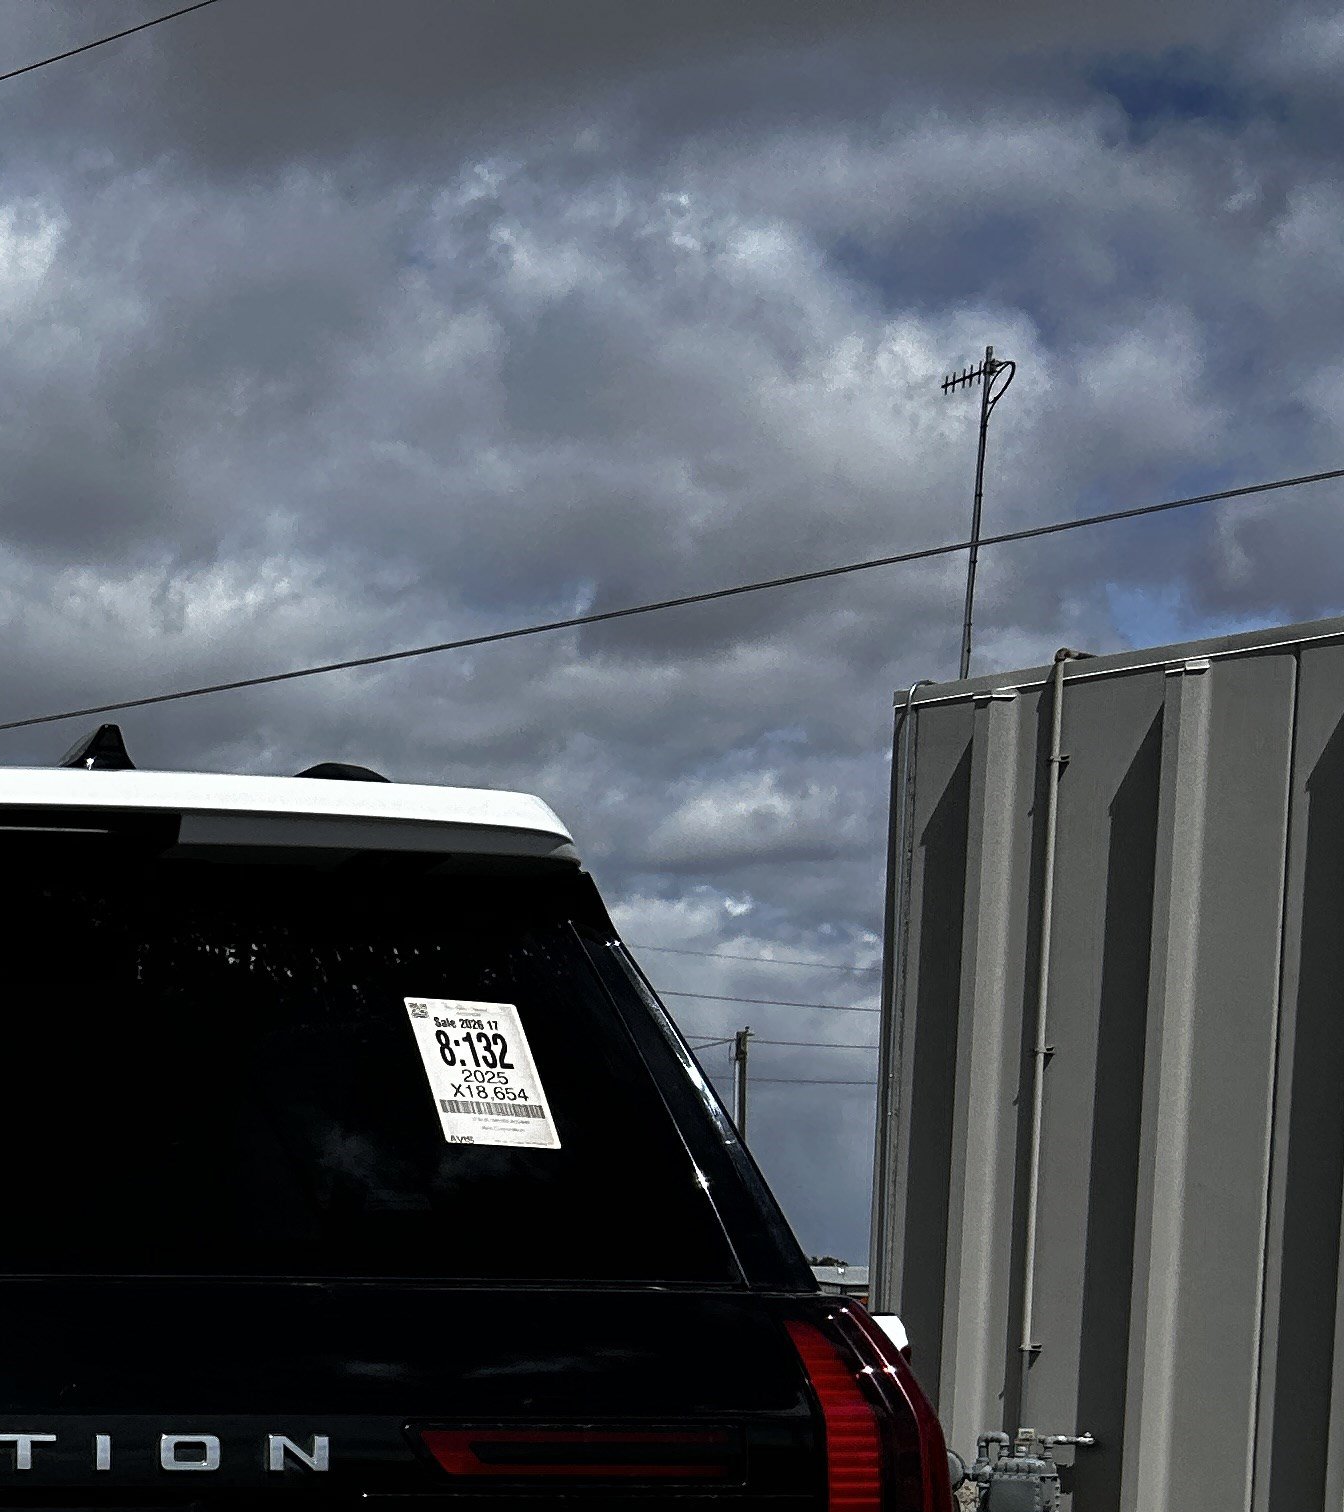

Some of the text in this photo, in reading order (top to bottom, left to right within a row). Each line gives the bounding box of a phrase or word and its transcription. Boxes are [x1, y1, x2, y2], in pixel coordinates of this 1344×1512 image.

[433, 1016, 499, 1031] Sale 2026 17
[435, 1029, 515, 1070] 8:132
[461, 1069, 509, 1085] 2025
